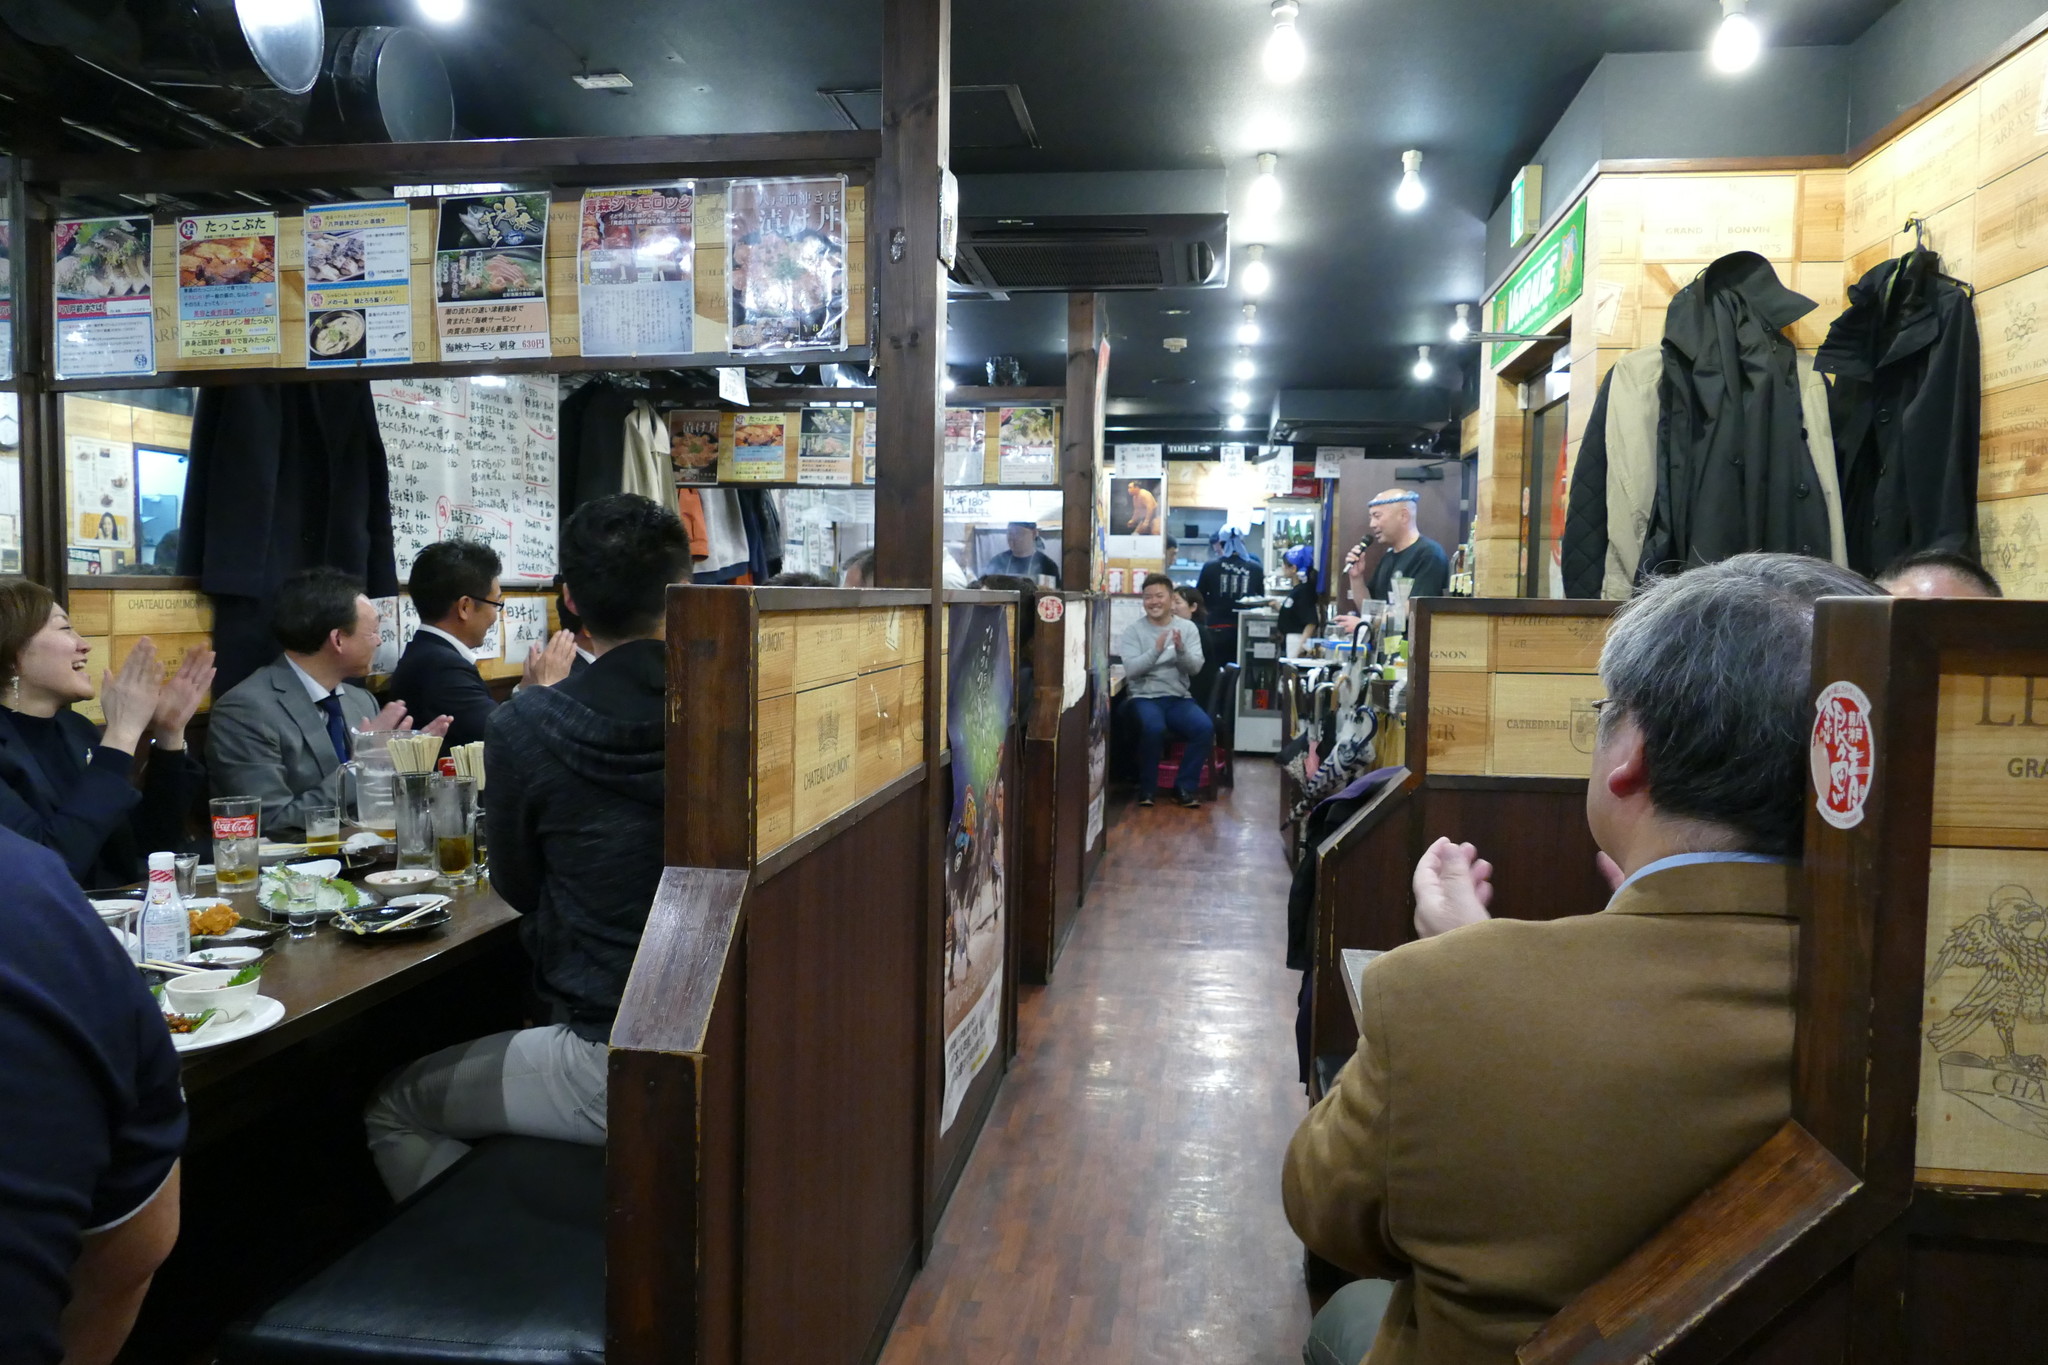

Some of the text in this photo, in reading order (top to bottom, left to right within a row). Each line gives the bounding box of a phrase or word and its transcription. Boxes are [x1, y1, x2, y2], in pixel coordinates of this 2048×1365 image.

[205, 217, 266, 232] たっこぶた
[1665, 226, 1703, 235] GRAND
[446, 338, 545, 353] 海峡サーモン 刺身 630円
[2002, 405, 2036, 419] CHATEAU
[1168, 444, 1200, 453] TOILET
[128, 599, 164, 610] CHATEAU
[1507, 719, 1568, 730] CATHEDRALE
